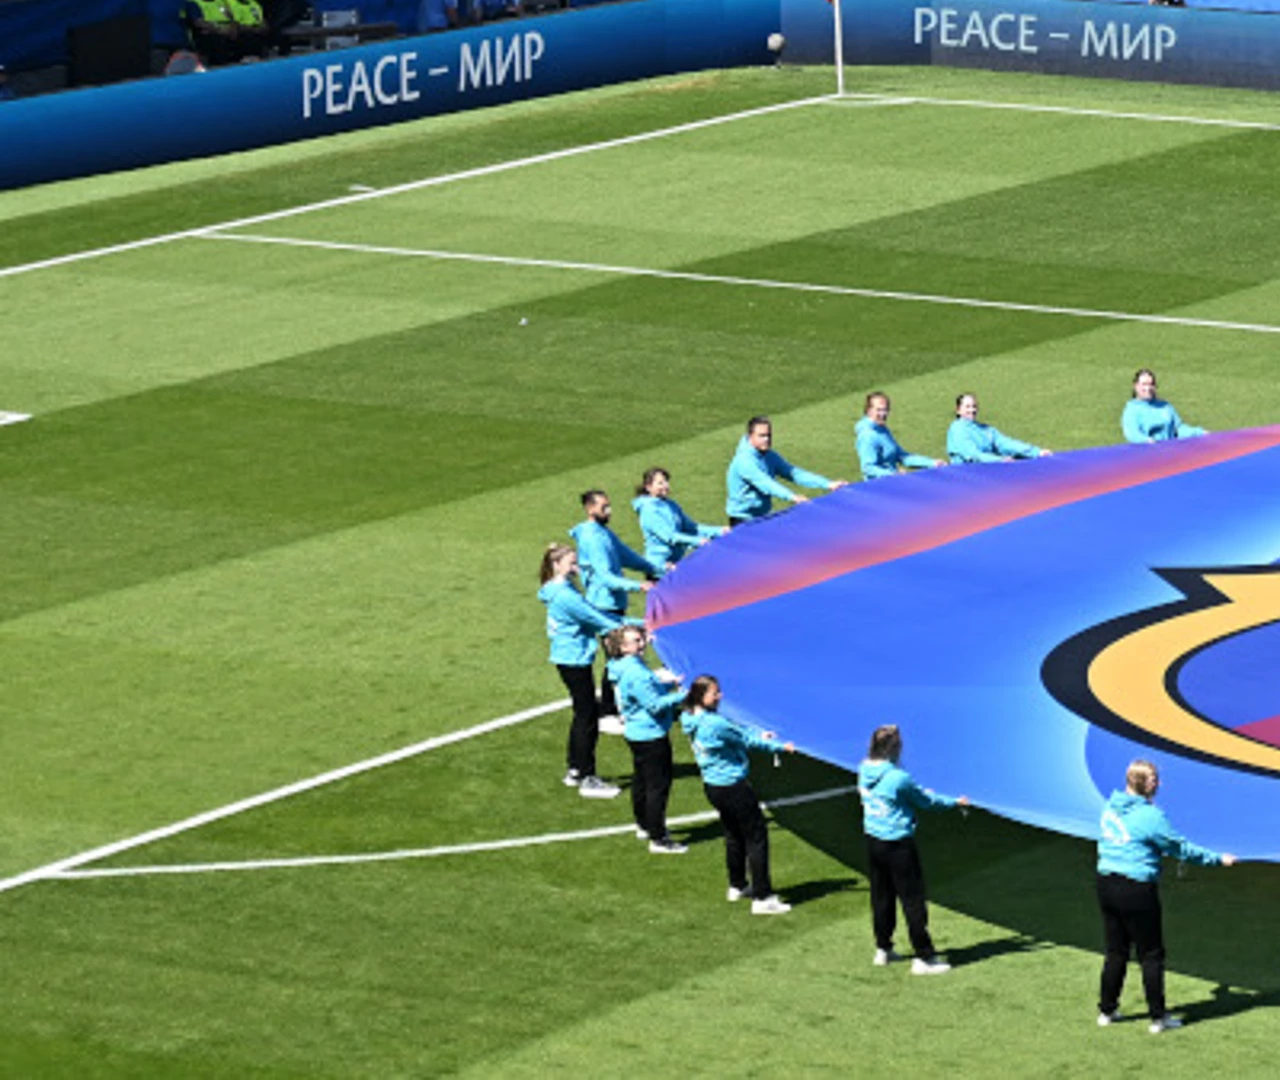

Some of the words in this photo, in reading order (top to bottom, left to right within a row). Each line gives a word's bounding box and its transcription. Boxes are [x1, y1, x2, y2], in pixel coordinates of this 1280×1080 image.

[914, 6, 1038, 54] PEACE
[1081, 20, 1177, 62] МИР
[303, 50, 421, 119] PEACE
[458, 30, 546, 93] МИР
